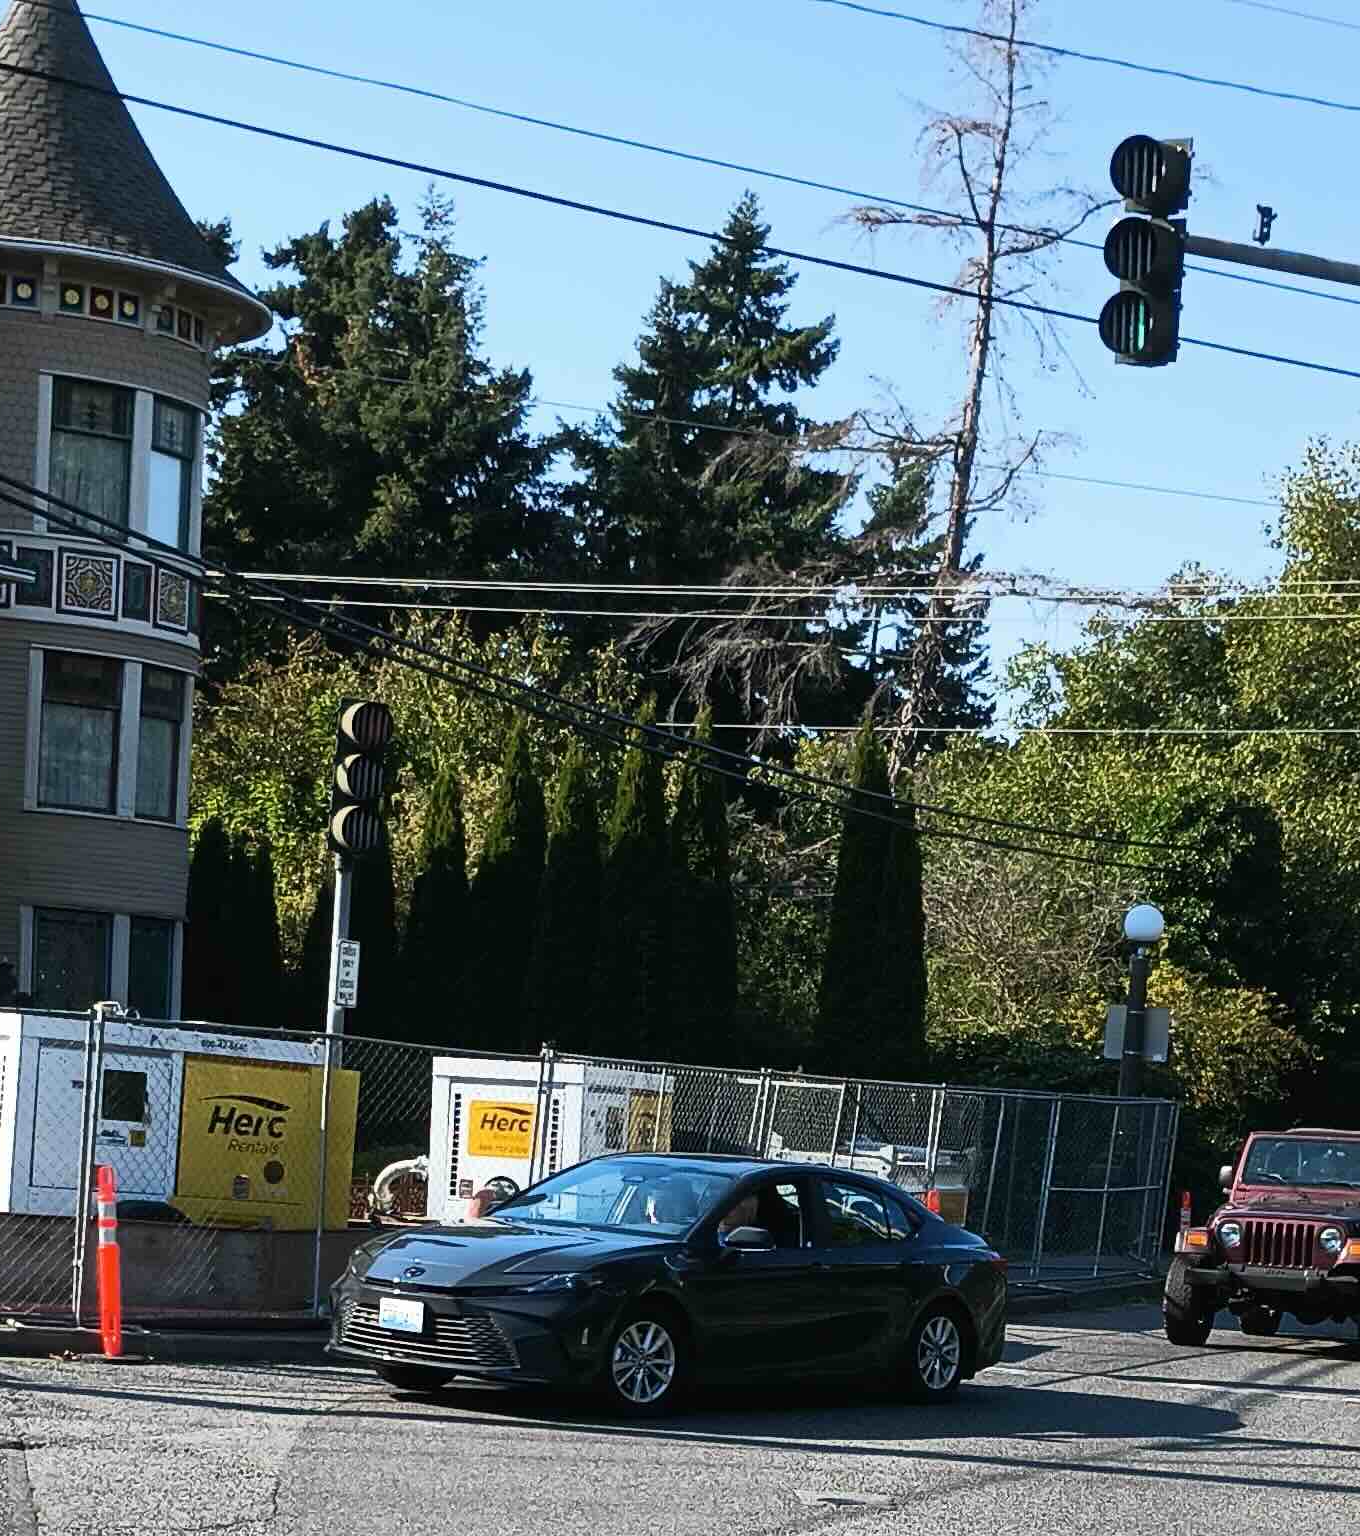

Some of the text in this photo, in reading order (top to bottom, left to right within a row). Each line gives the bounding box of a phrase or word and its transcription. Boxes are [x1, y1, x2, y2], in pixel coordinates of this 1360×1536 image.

[207, 1104, 287, 1138] Herc
[480, 1113, 530, 1133] Herc
[227, 1138, 280, 1154] Rentals
